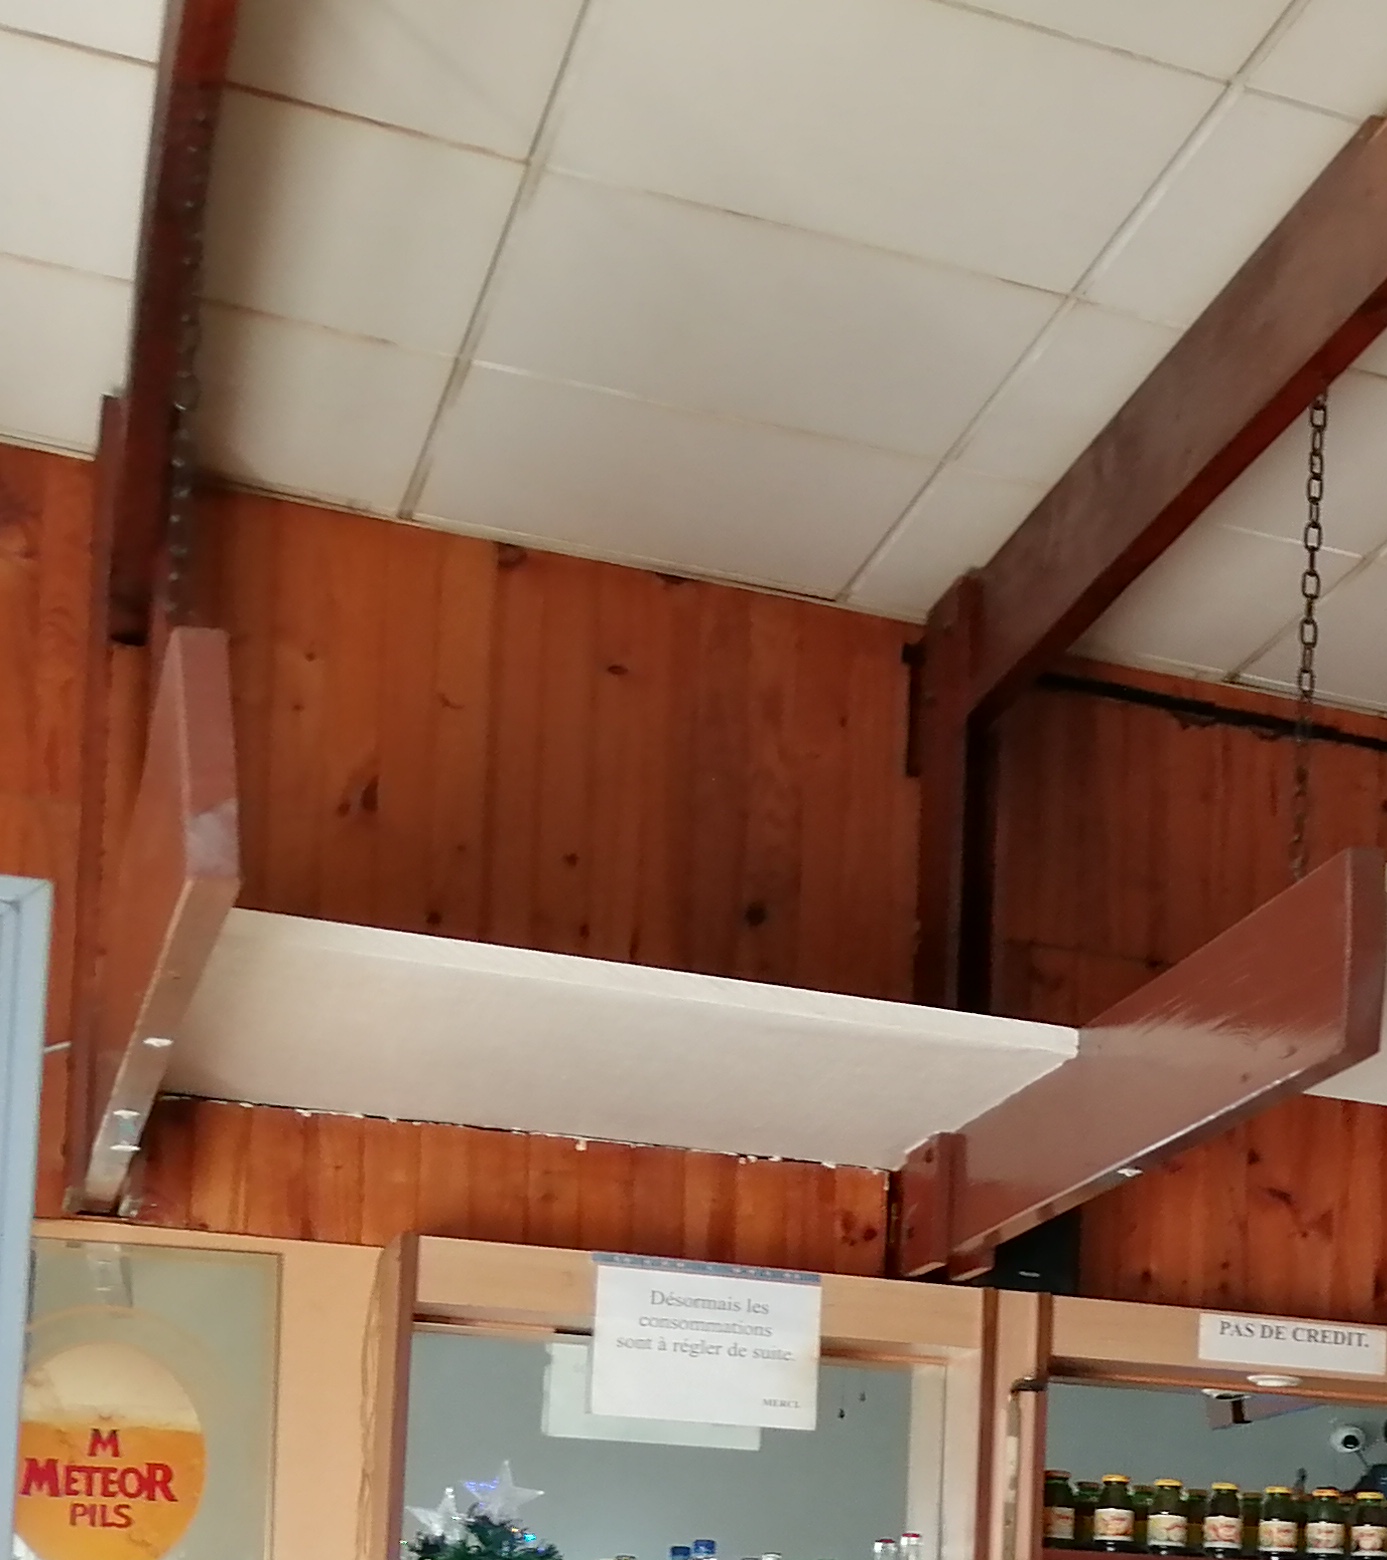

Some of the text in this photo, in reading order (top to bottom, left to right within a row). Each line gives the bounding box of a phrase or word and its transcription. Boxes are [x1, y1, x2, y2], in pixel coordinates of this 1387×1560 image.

[650, 1289, 770, 1315] Désormais les
[638, 1314, 773, 1337] consommations
[1219, 1320, 1370, 1348] PAS DE CREDIT.
[616, 1334, 652, 1350] sont
[657, 1335, 667, 1351] à
[672, 1338, 722, 1358] régler
[727, 1342, 747, 1358] de
[87, 1428, 122, 1458] M
[19, 1457, 179, 1502] METEOR
[69, 1502, 134, 1529] PILS
